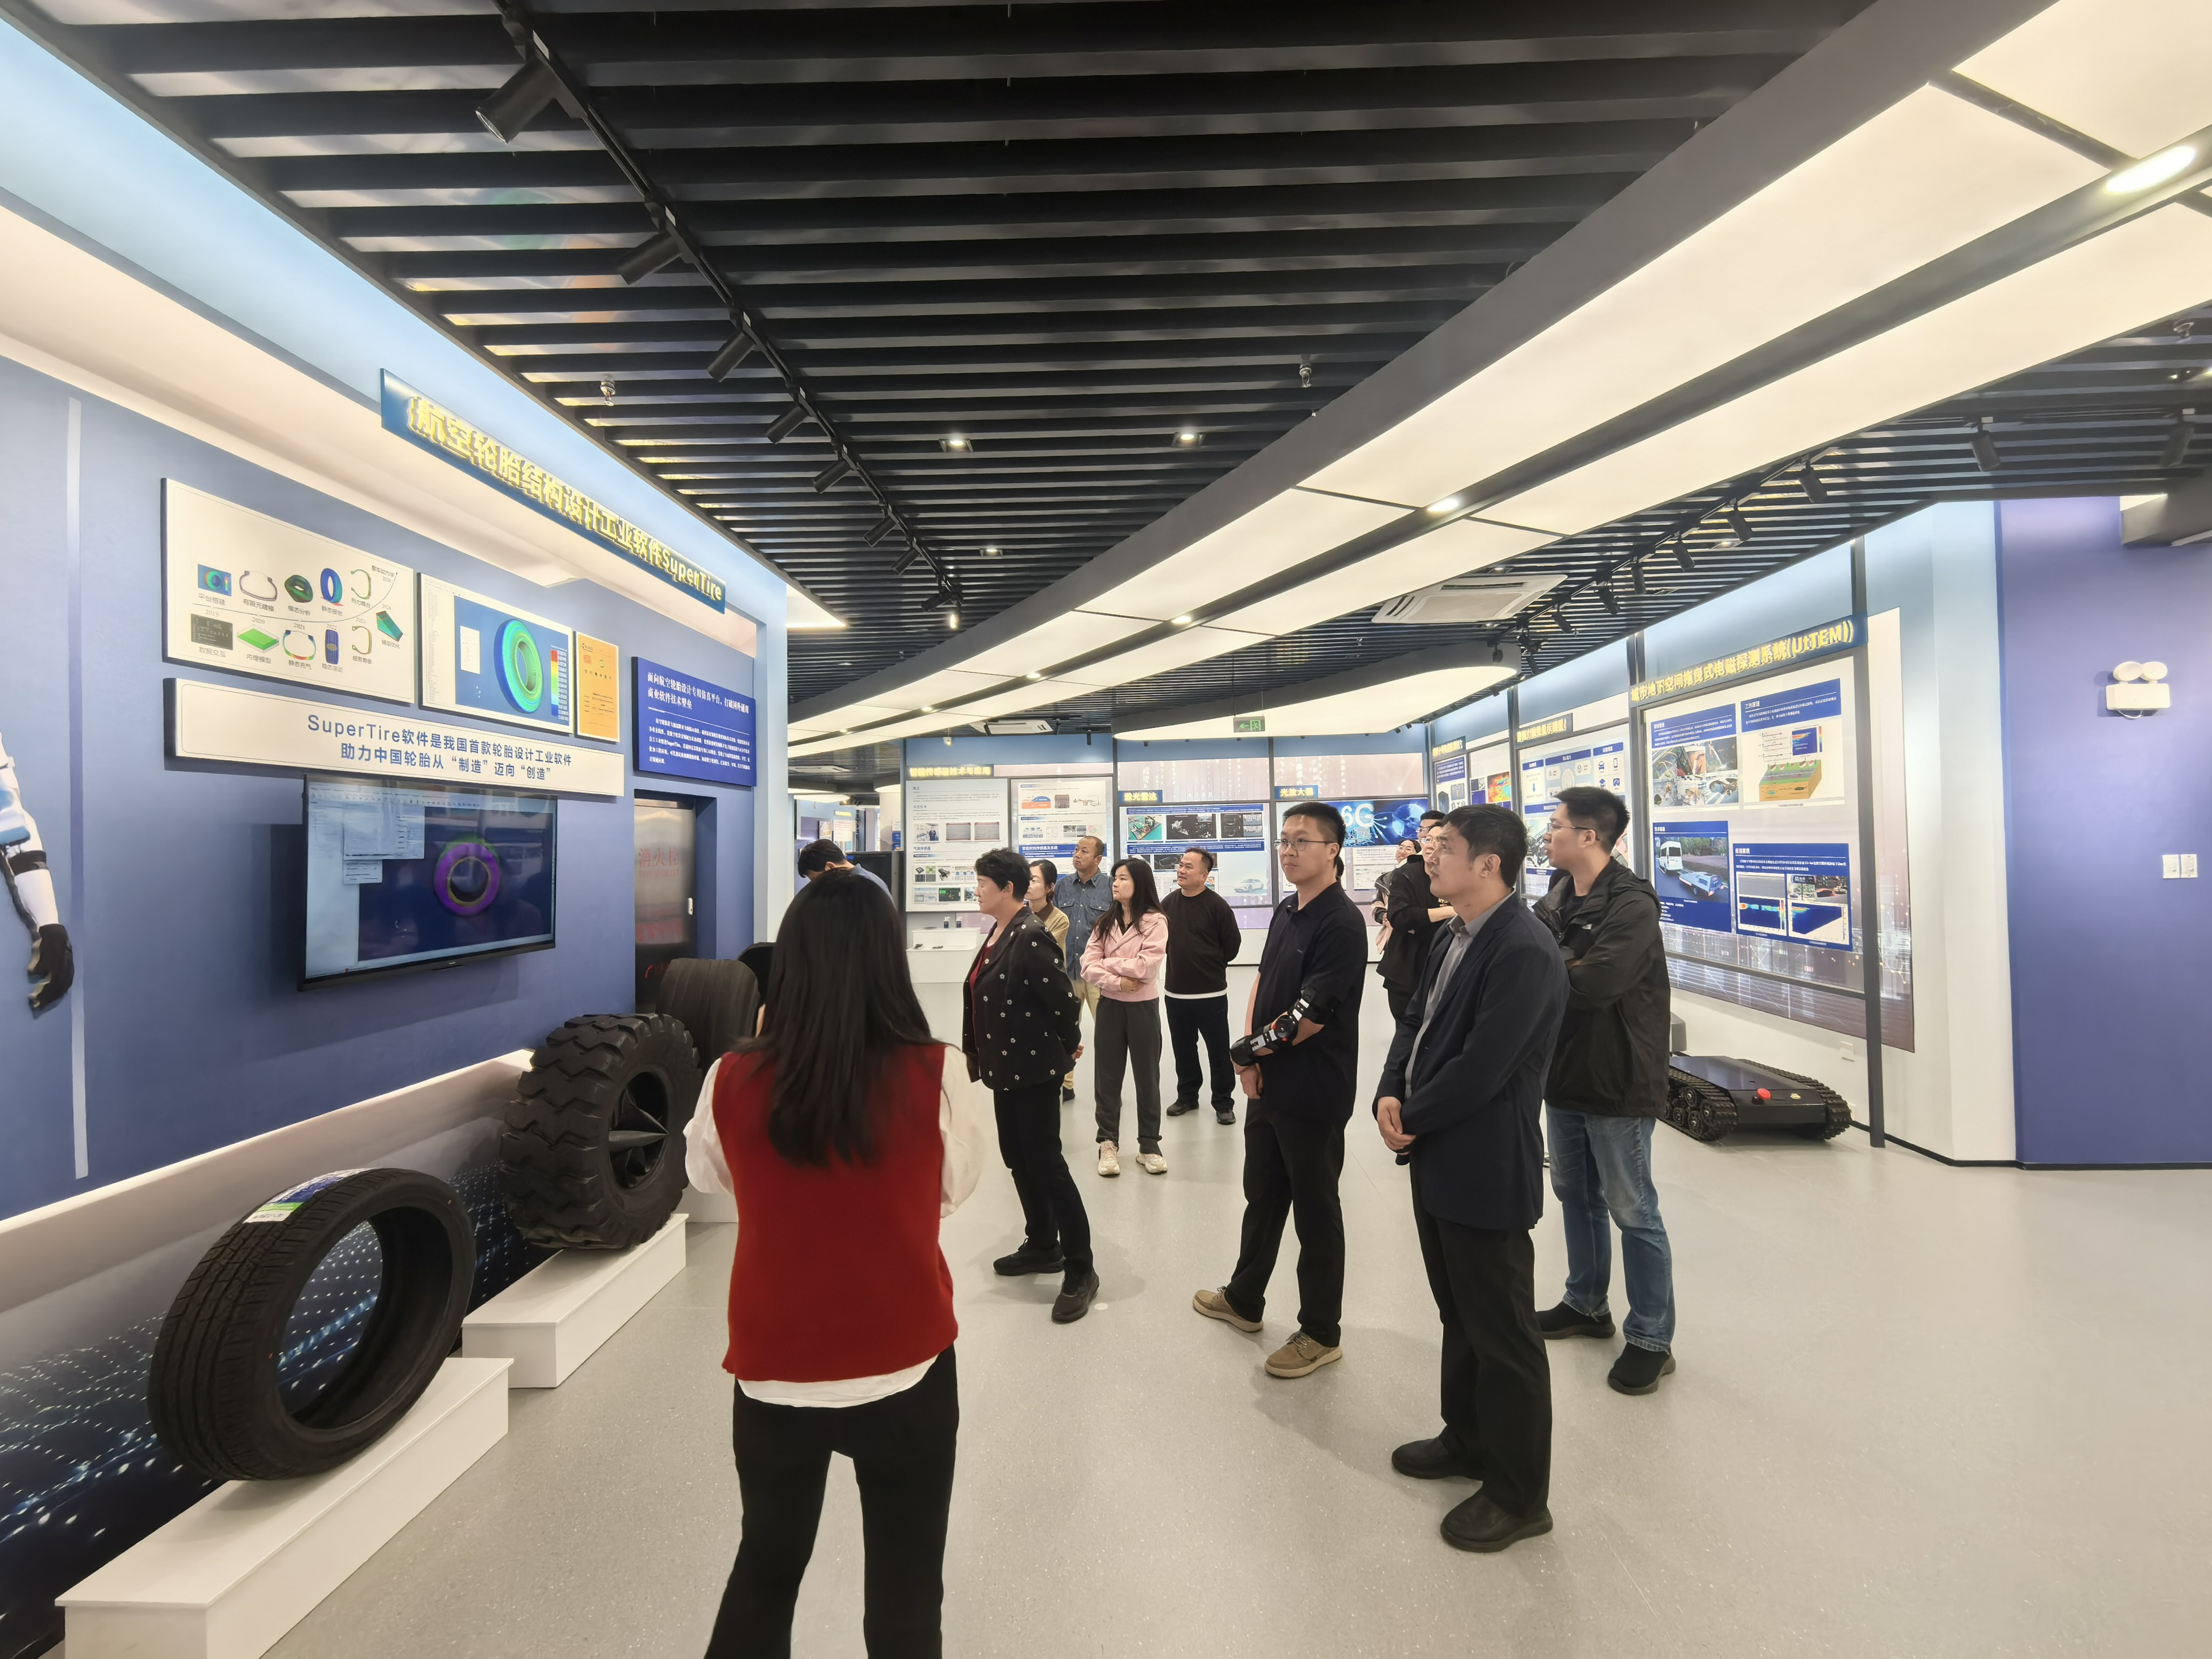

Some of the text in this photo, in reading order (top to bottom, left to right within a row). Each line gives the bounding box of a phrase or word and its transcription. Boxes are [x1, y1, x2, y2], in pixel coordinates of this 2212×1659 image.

[408, 397, 723, 601] 航空轮胎结构设计工业软件SuperTire
[198, 593, 226, 605] 平台搭建
[243, 598, 274, 611] 有限元建模
[288, 605, 311, 616] 模态分析
[308, 714, 571, 766] SuperTire软件是我国首款轮胎设计工业软件
[1124, 792, 1158, 801] 激光雷达
[1280, 787, 1314, 798] 光放大器
[1340, 803, 1375, 828] 6G
